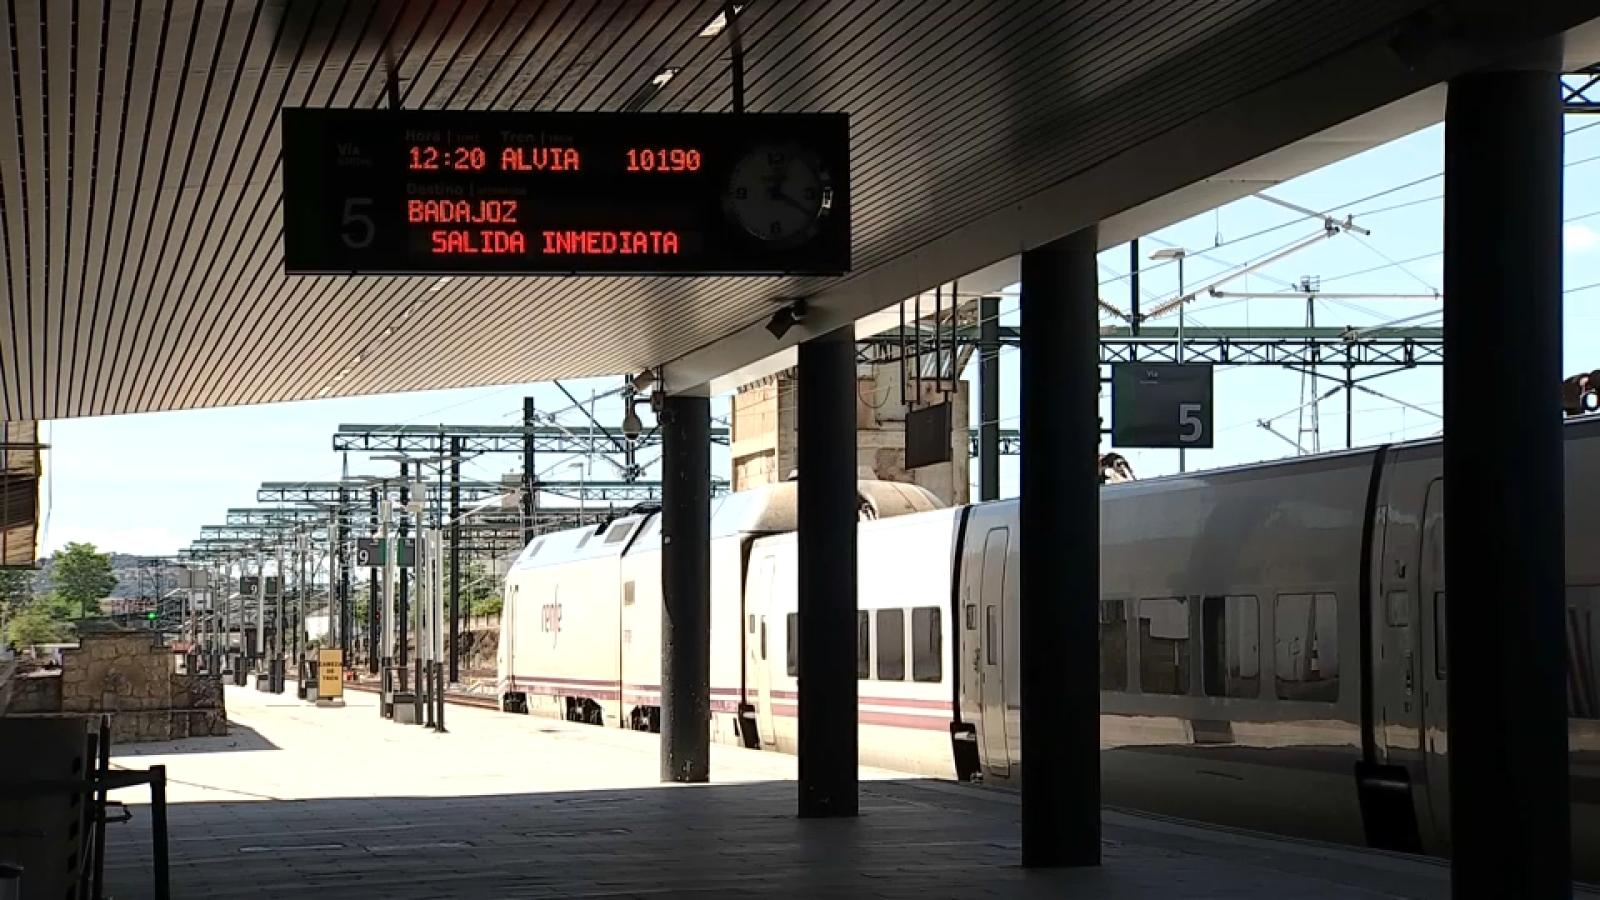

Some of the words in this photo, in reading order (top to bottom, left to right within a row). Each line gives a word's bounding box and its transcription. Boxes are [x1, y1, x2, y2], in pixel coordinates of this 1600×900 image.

[405, 130, 441, 142] Hora
[500, 131, 535, 142] Tren
[408, 146, 486, 170] 12:20
[501, 147, 581, 171] ALVIA
[625, 148, 702, 171] 10190
[341, 197, 376, 248] 5
[407, 199, 519, 223] BADAJOZ
[431, 230, 526, 254] SALIDA
[543, 231, 679, 254] INMEDIATA
[1179, 404, 1202, 443] 5
[359, 549, 369, 565] 9
